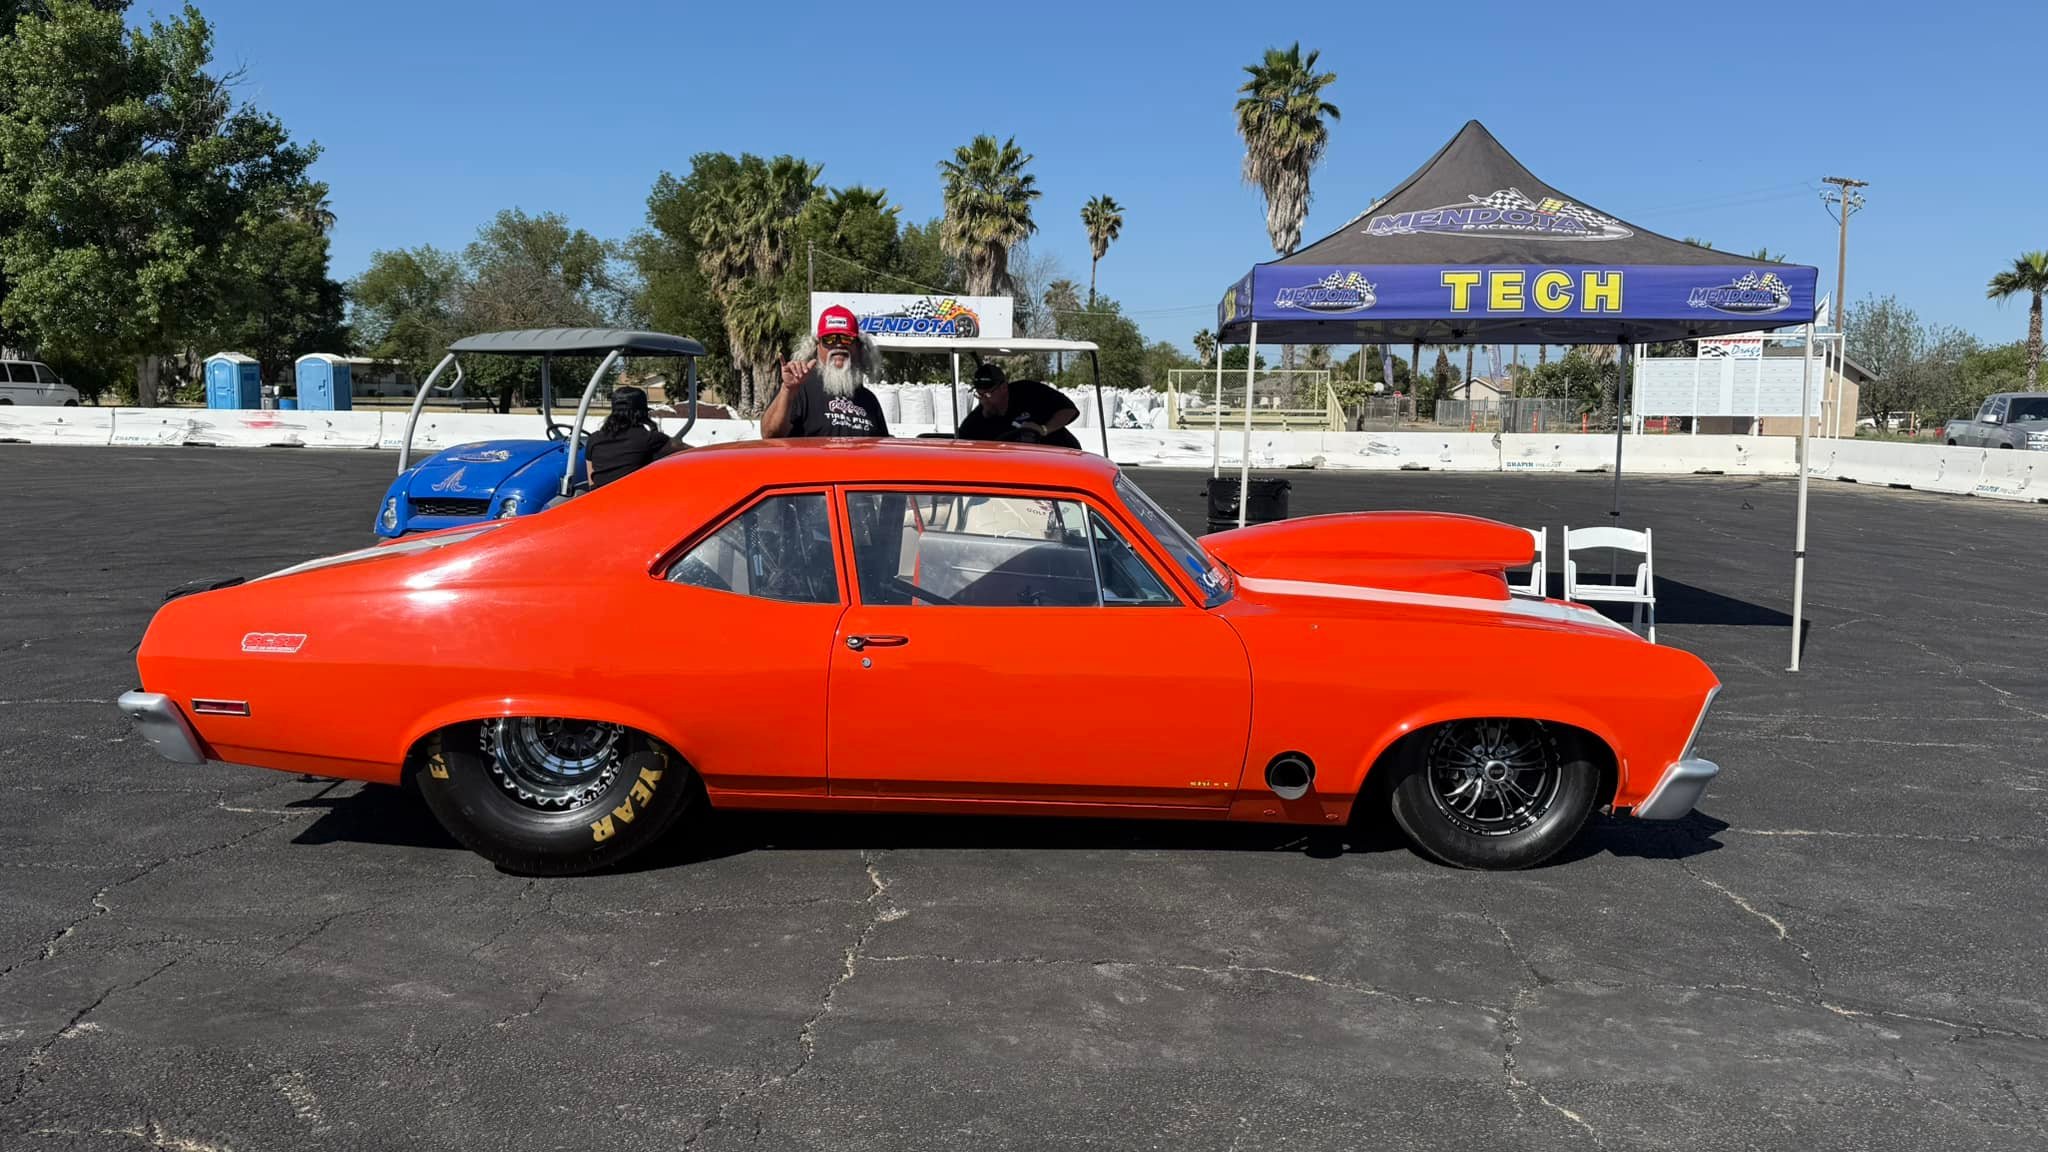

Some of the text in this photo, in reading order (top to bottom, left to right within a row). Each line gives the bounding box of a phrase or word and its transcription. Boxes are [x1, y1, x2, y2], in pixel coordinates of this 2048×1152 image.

[1368, 208, 1588, 232] MENDOTA
[1462, 223, 1602, 236] RACEWAY PARK
[1277, 287, 1361, 302] MENDOTA
[1441, 269, 1624, 313] TECH
[1688, 287, 1774, 302] MENDOTA
[589, 766, 664, 842] YEAR
